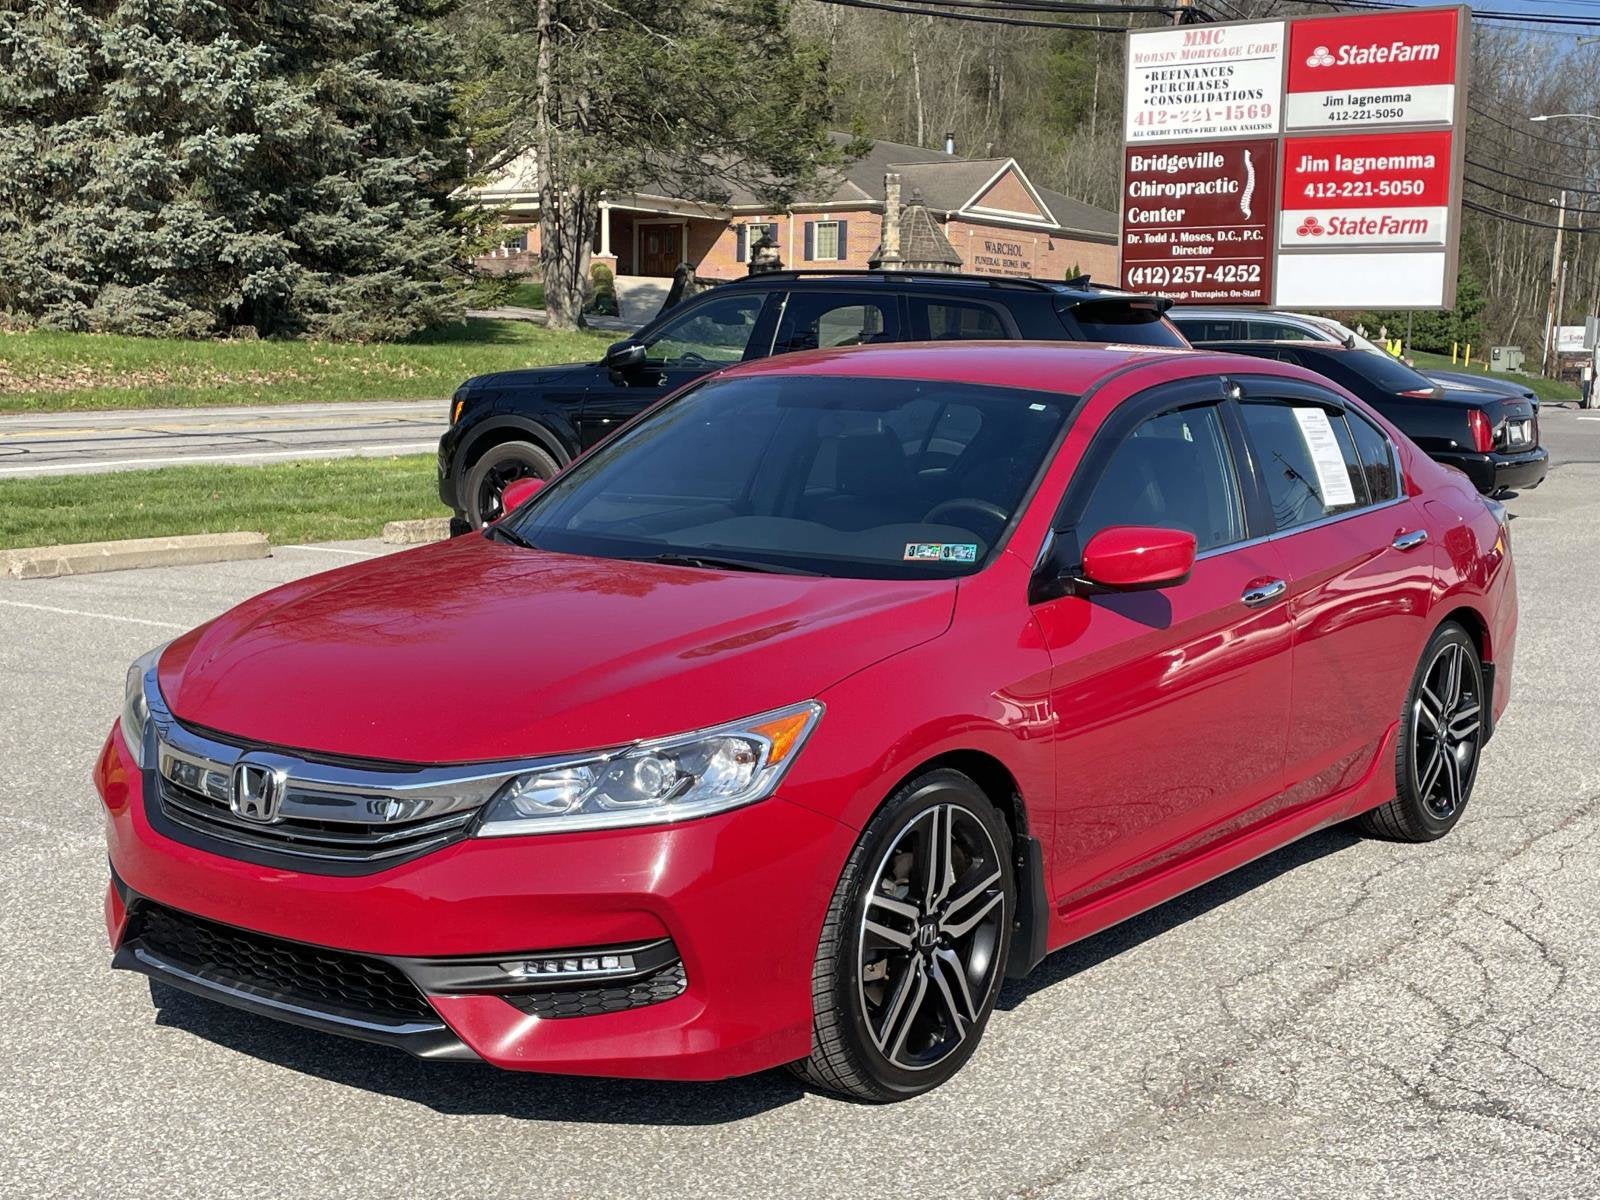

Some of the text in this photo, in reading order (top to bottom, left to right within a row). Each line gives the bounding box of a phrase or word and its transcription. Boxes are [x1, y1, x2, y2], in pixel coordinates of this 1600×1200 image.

[1183, 29, 1226, 46] MMC
[1151, 65, 1234, 81] REFINANCES
[1151, 79, 1230, 94] PURCHASES
[1150, 89, 1264, 106] CONSOLIDATIONS
[1322, 95, 1344, 107] Jim
[1134, 103, 1272, 126] 412-221-1569
[1328, 108, 1404, 121] 412-221-5050
[1239, 123, 1273, 131] ANALYSIS
[1130, 152, 1224, 173] Bridgeville
[1295, 155, 1329, 173] Jim
[1129, 177, 1239, 198] Chiropractic
[1304, 180, 1425, 198] 412-221-5050
[1128, 207, 1185, 223] Center
[1127, 233, 1142, 244] Dr.
[1144, 232, 1168, 243] Todd
[1169, 232, 1178, 243] J.
[1180, 231, 1215, 243] Moses,
[1243, 230, 1264, 240] P.C.
[984, 241, 1023, 256] WARCHOL
[1172, 245, 1214, 255] Director
[1191, 290, 1228, 299] Therapists
[1230, 289, 1261, 298] On-Staff
